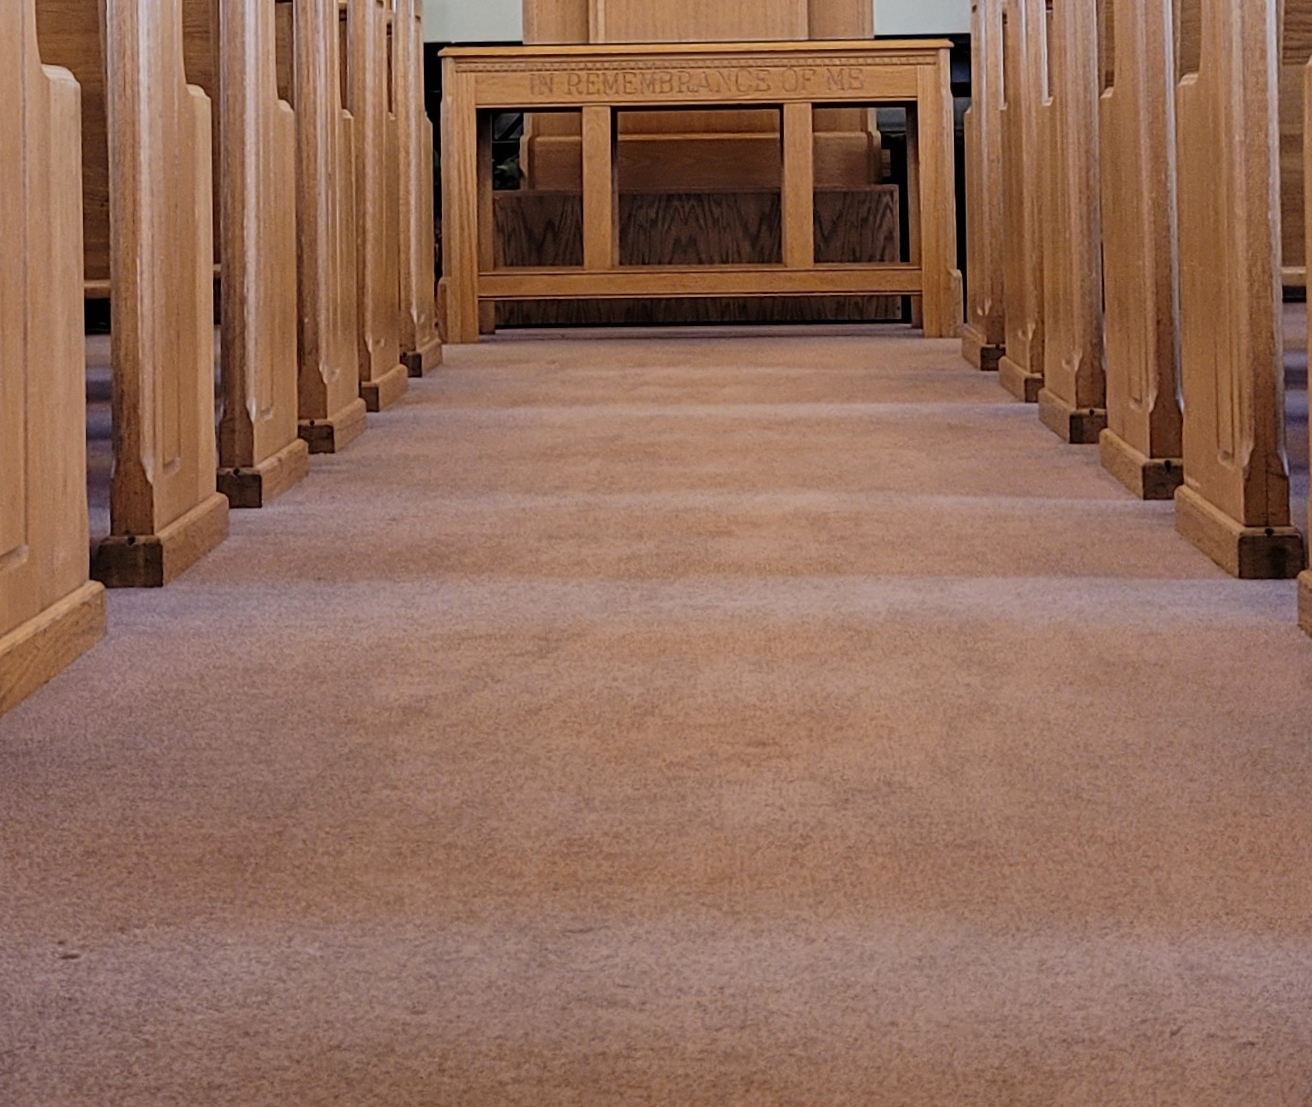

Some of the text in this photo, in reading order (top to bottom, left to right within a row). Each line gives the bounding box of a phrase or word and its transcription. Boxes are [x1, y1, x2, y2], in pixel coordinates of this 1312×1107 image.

[529, 67, 865, 95] IN REMEMBRANCE OF ME
